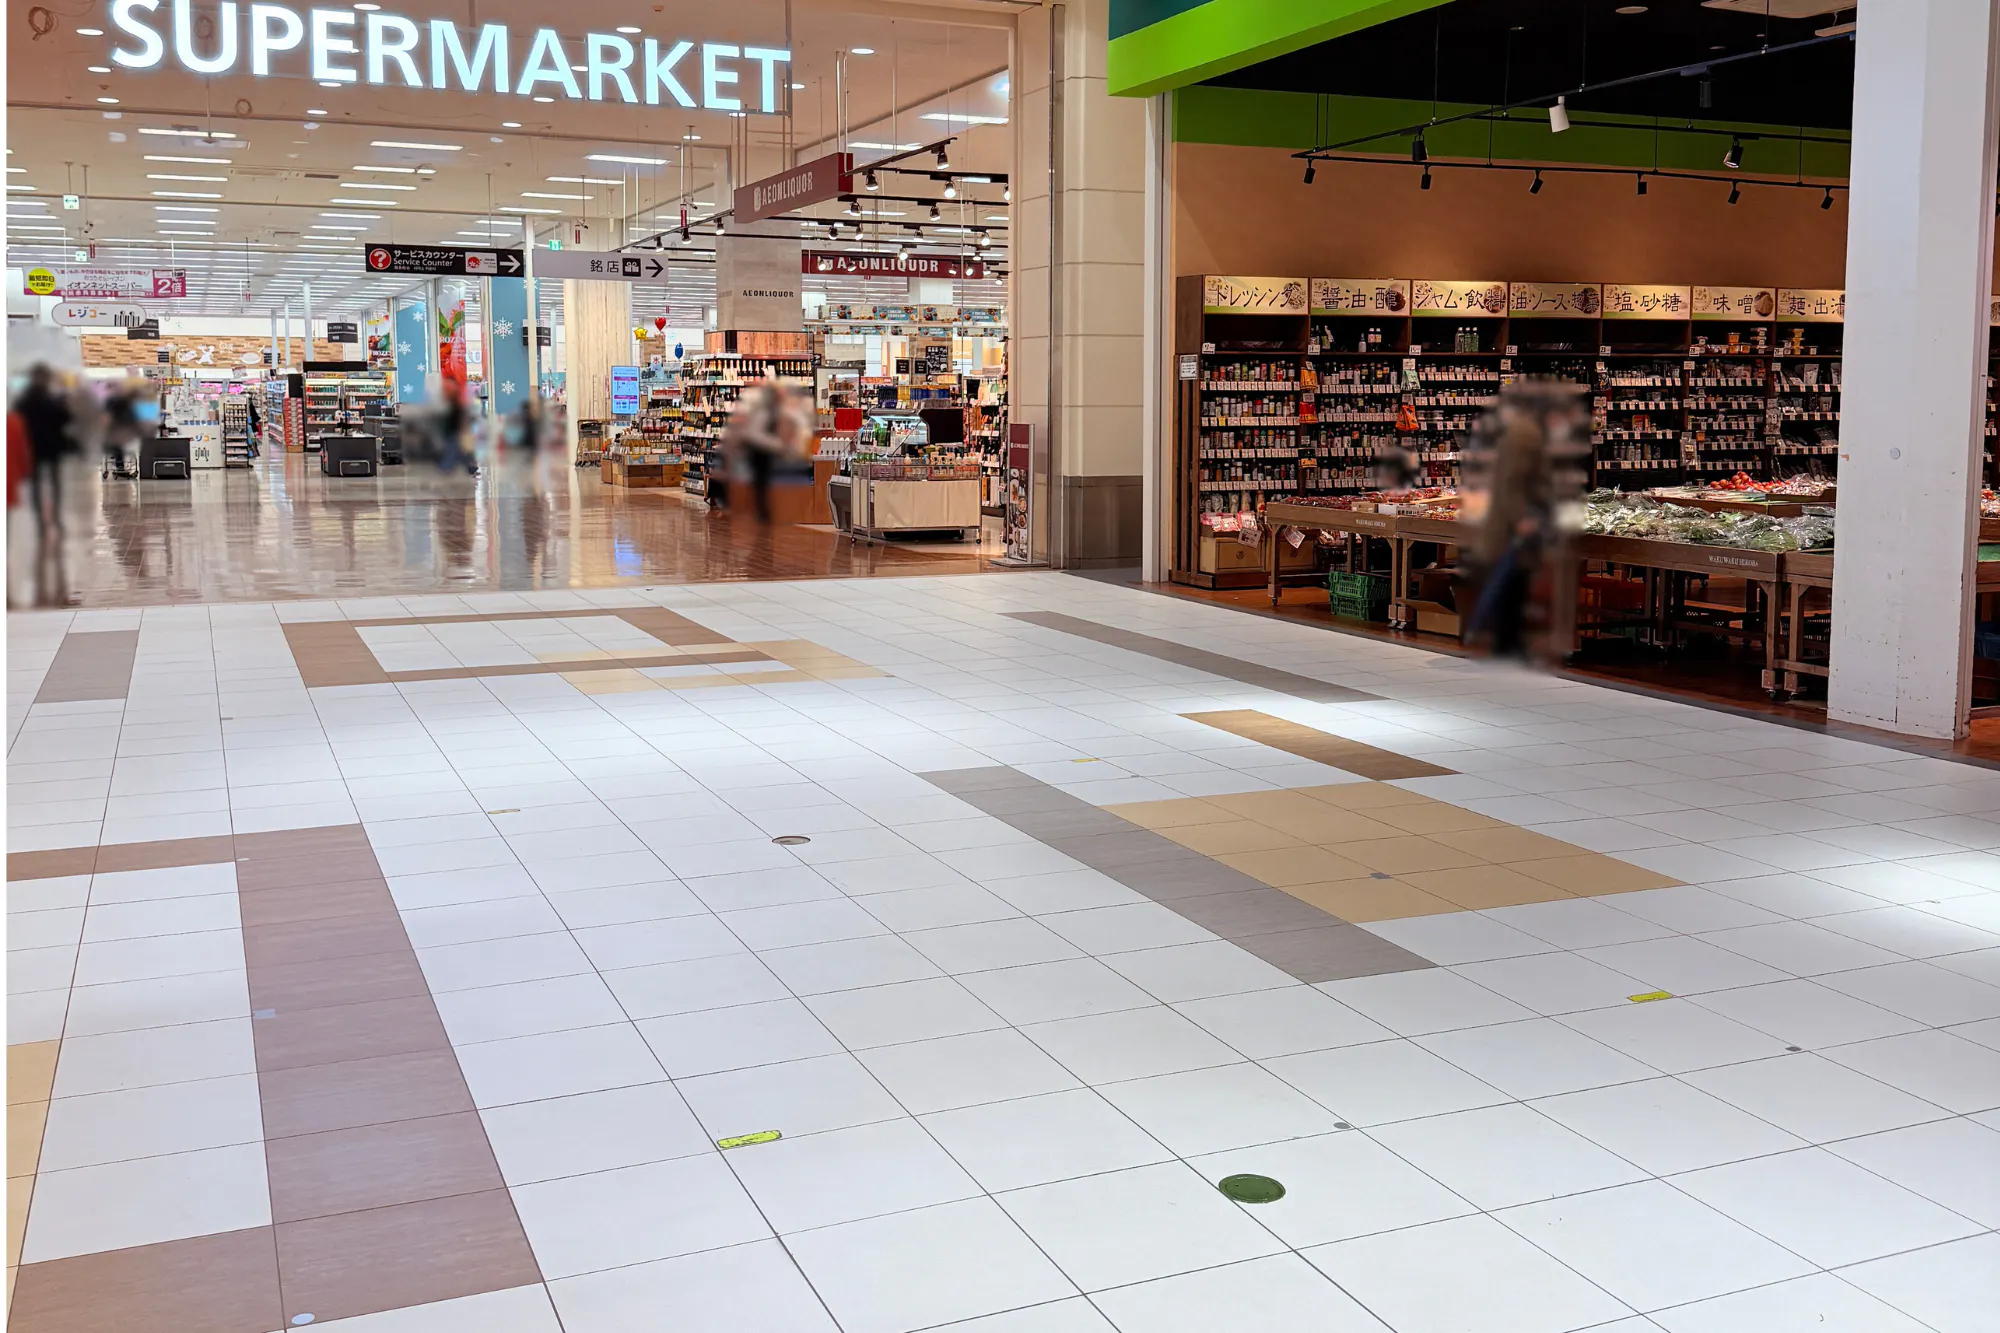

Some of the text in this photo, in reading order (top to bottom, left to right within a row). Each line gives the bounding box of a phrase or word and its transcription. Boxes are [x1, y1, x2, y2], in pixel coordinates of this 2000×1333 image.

[110, 0, 794, 115] SUPERMARKET
[762, 171, 813, 206] AEONLIQUOR
[393, 250, 464, 259] サービスカウンター
[393, 258, 453, 267] Service Counter
[590, 259, 619, 273] 銘店
[837, 256, 939, 273] AONLIQUOR
[67, 281, 143, 290] イオンネットスーパー
[742, 289, 794, 298] AEONLIQUOR
[1216, 284, 1296, 308] ドレッシング
[1415, 287, 1506, 311] ジャム・飲料
[1614, 292, 1683, 313] 塩・砂糖
